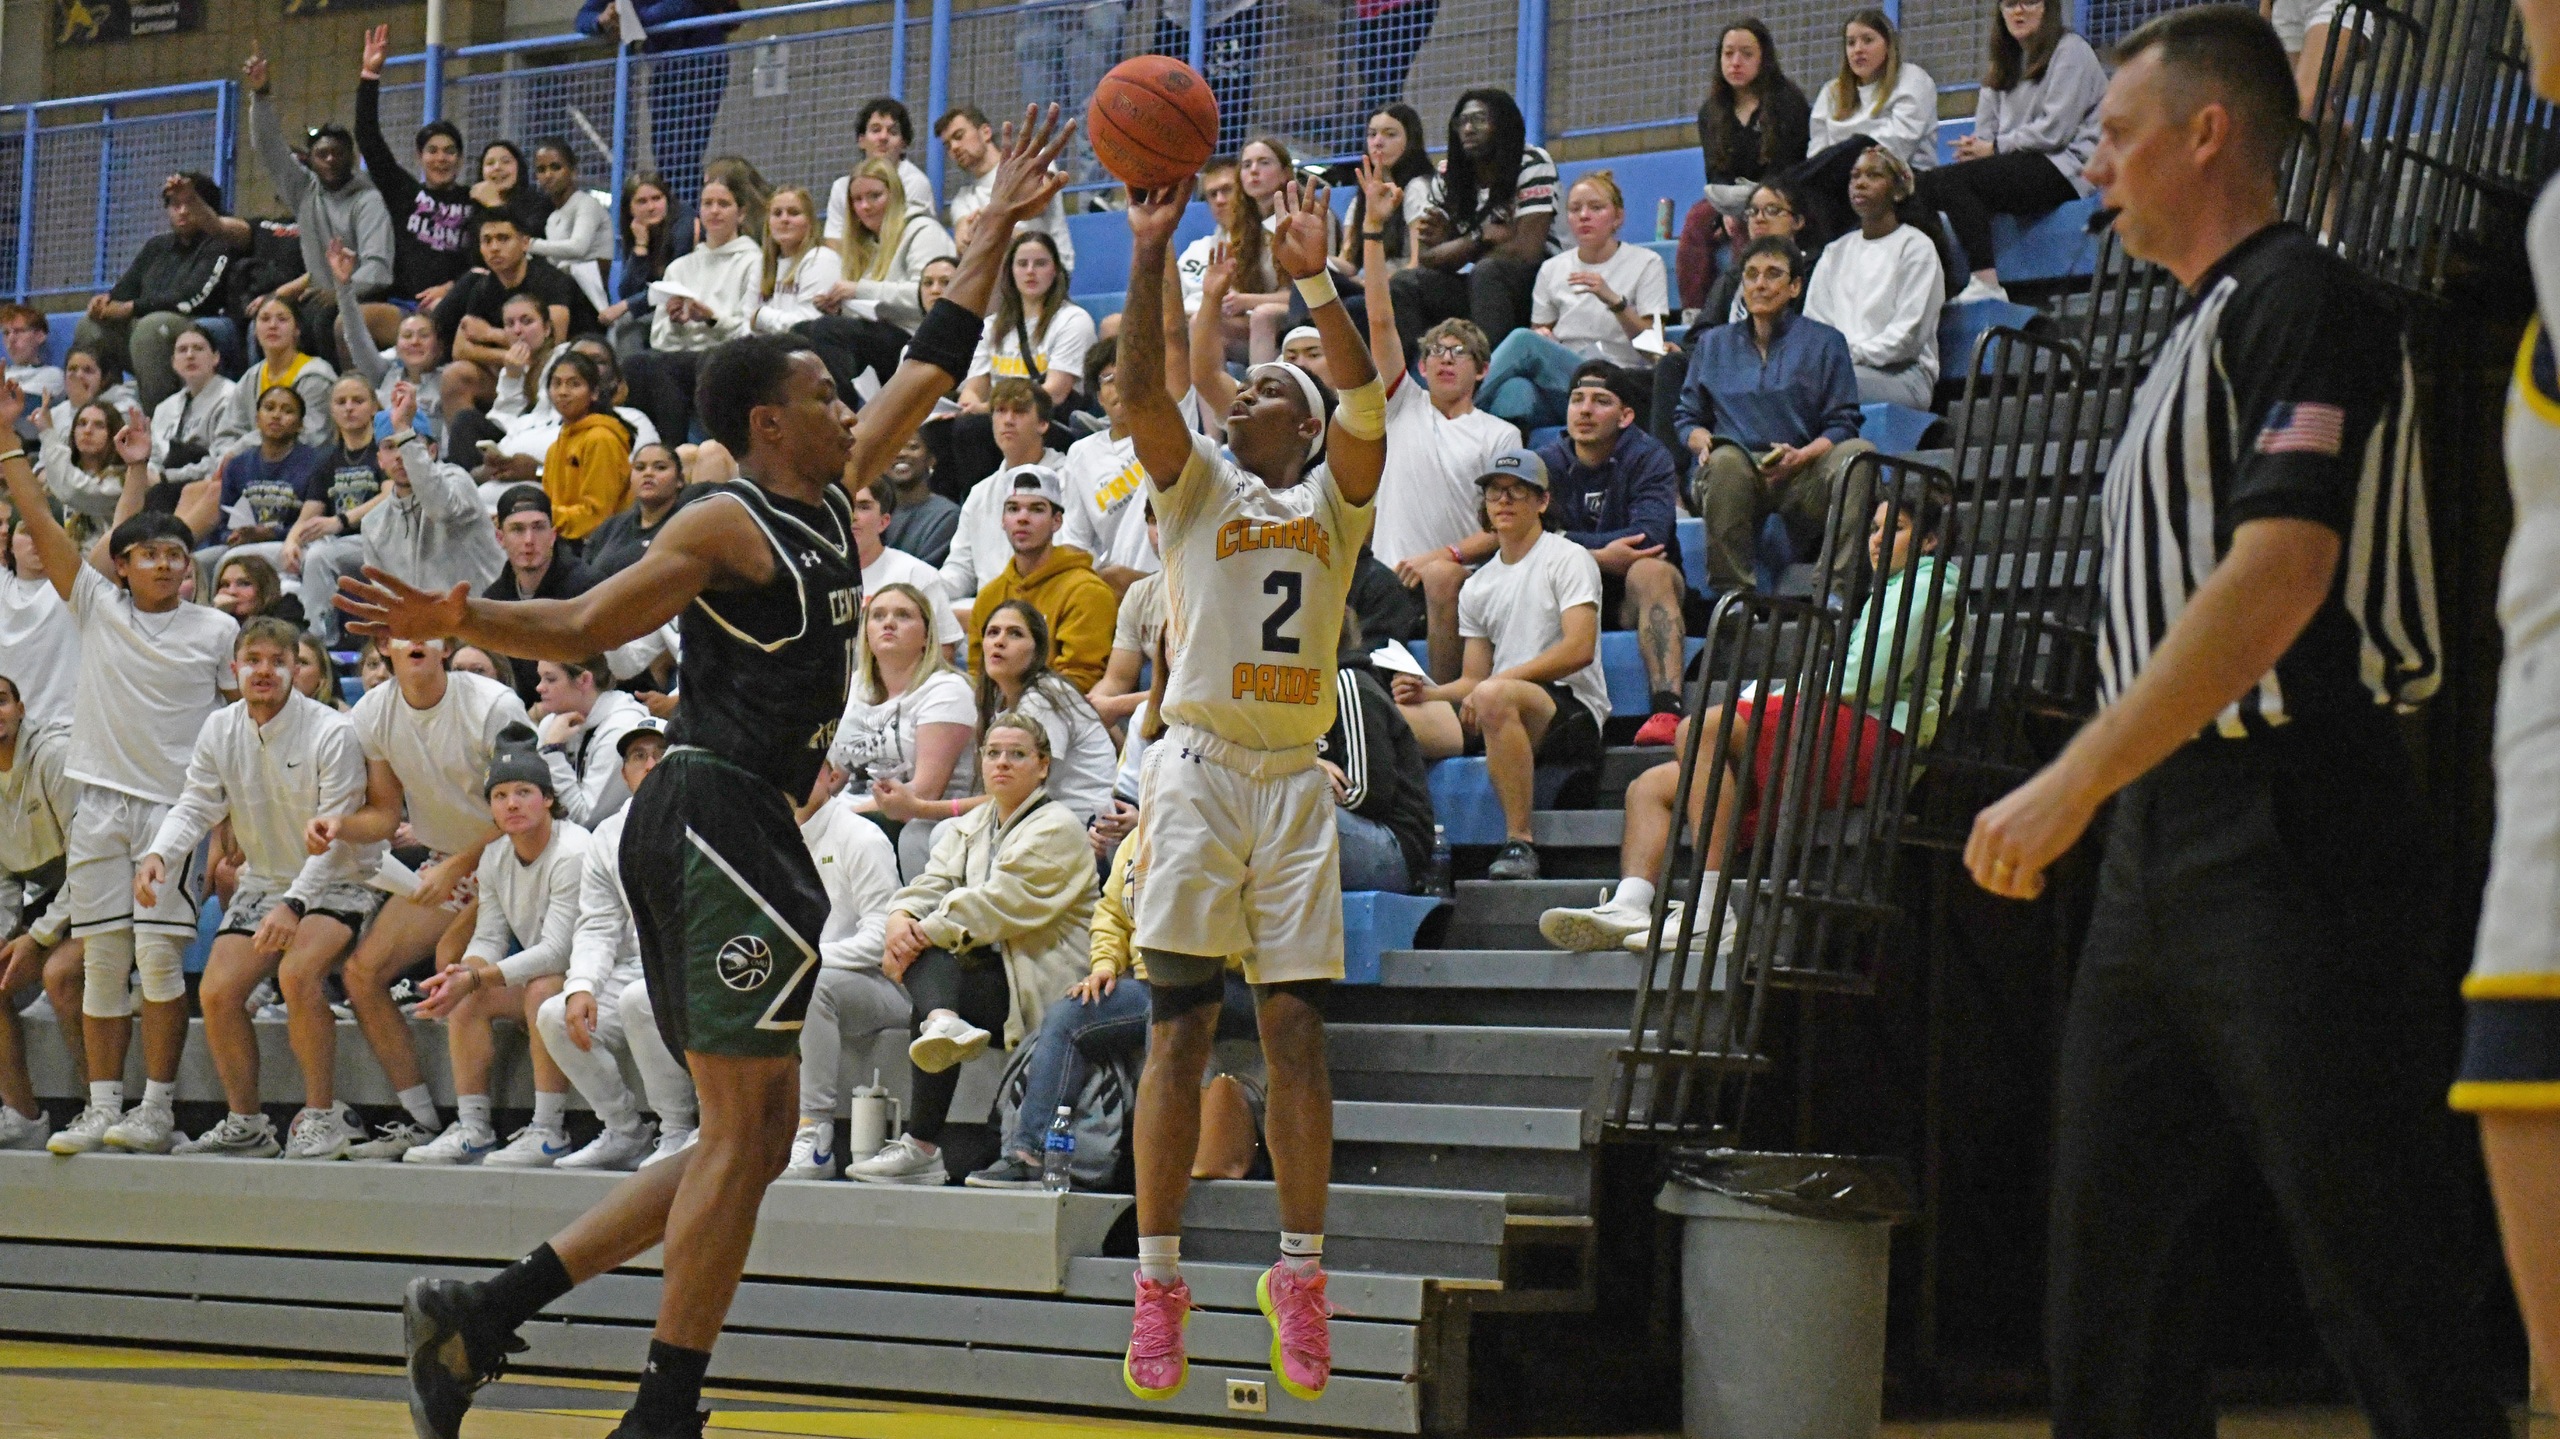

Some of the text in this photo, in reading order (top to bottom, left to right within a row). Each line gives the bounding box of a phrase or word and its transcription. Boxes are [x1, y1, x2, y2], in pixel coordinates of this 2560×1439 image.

[1216, 516, 1330, 570] CLARKE
[1262, 570, 1302, 654] 2
[1232, 662, 1321, 705] PRIDE
